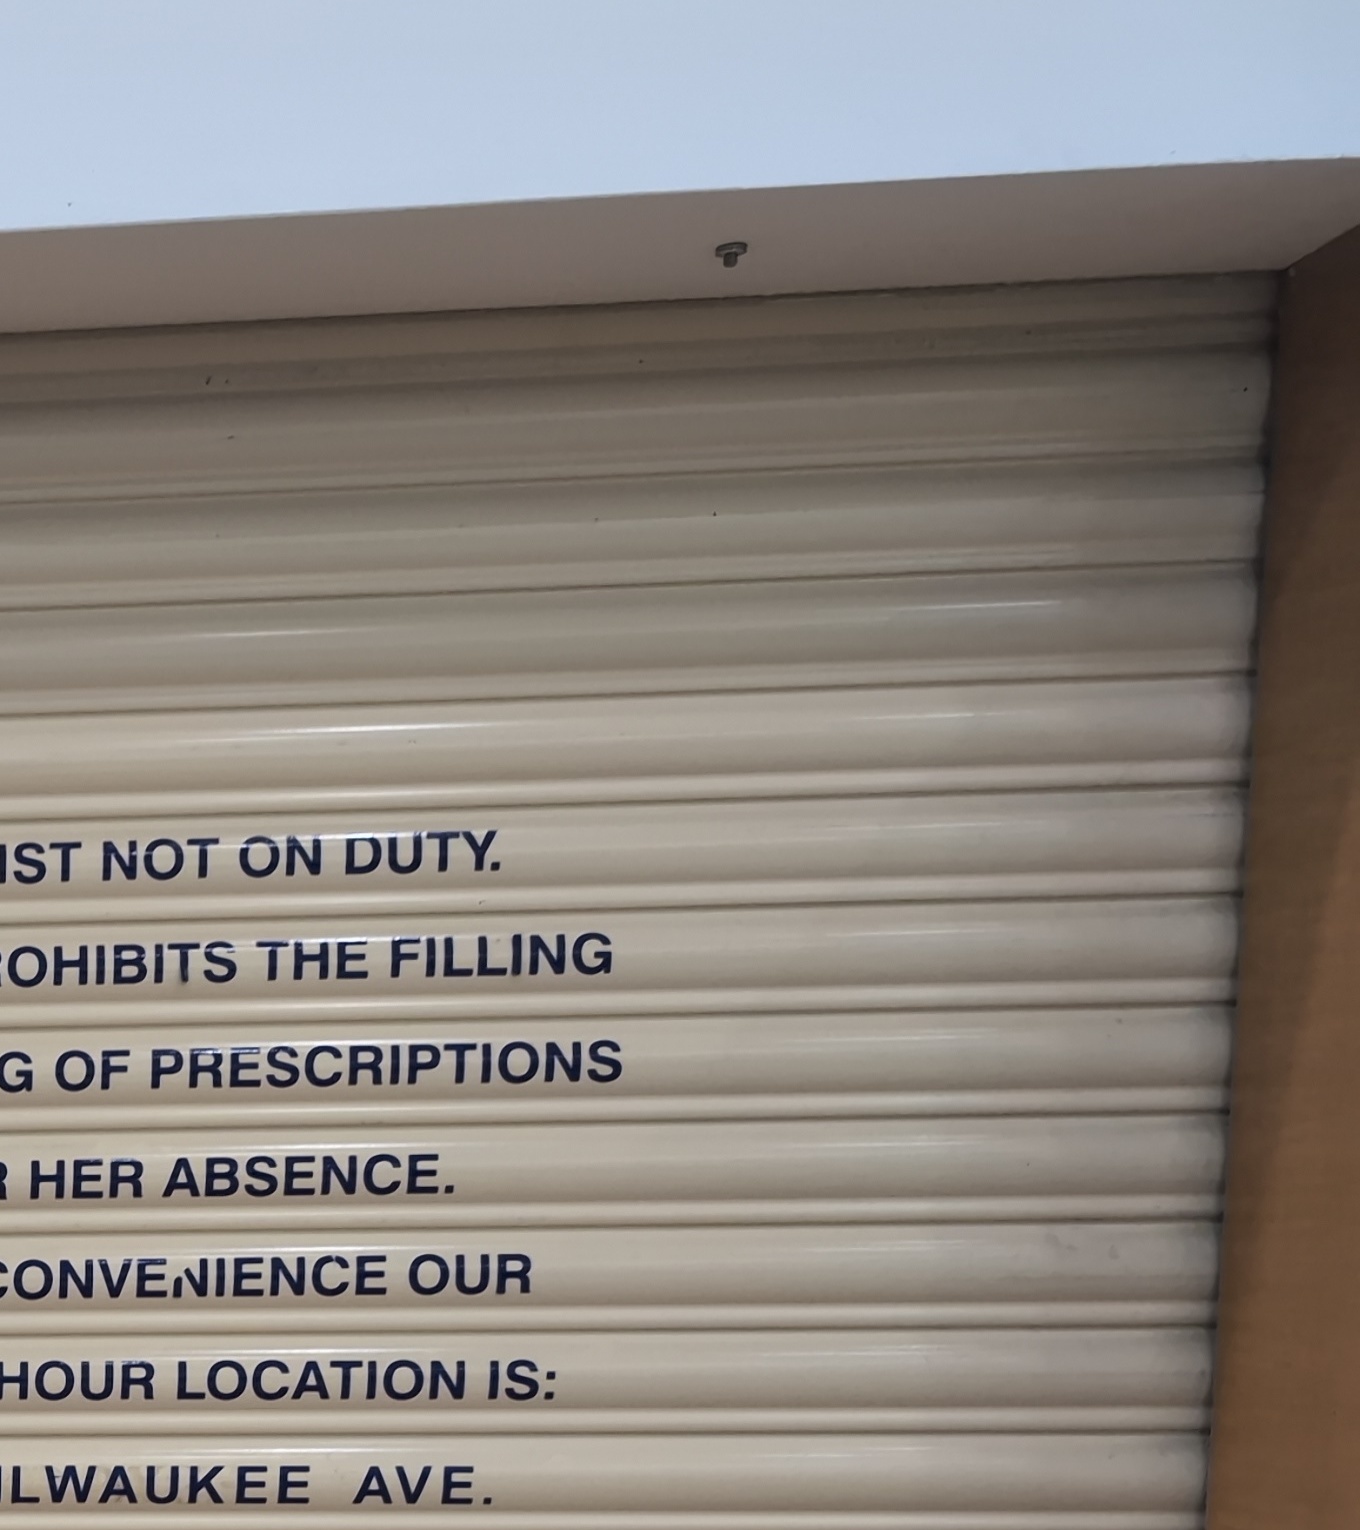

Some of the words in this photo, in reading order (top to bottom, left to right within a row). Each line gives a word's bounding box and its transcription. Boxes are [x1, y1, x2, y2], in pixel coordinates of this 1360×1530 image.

[102, 837, 220, 882] NOT
[239, 836, 322, 879] ON
[345, 830, 501, 875] DUTY.
[256, 941, 369, 982] THE
[390, 932, 613, 979] FILLING
[55, 1049, 131, 1092] OF
[150, 1039, 623, 1090] PRESCRIPTIONS
[29, 1159, 144, 1200] HER
[161, 1153, 455, 1198] ABSENCE.
[408, 1253, 532, 1296] OUR
[176, 1359, 466, 1401] LOCATION
[487, 1359, 556, 1402] IS:
[352, 1465, 492, 1505] AVE.
